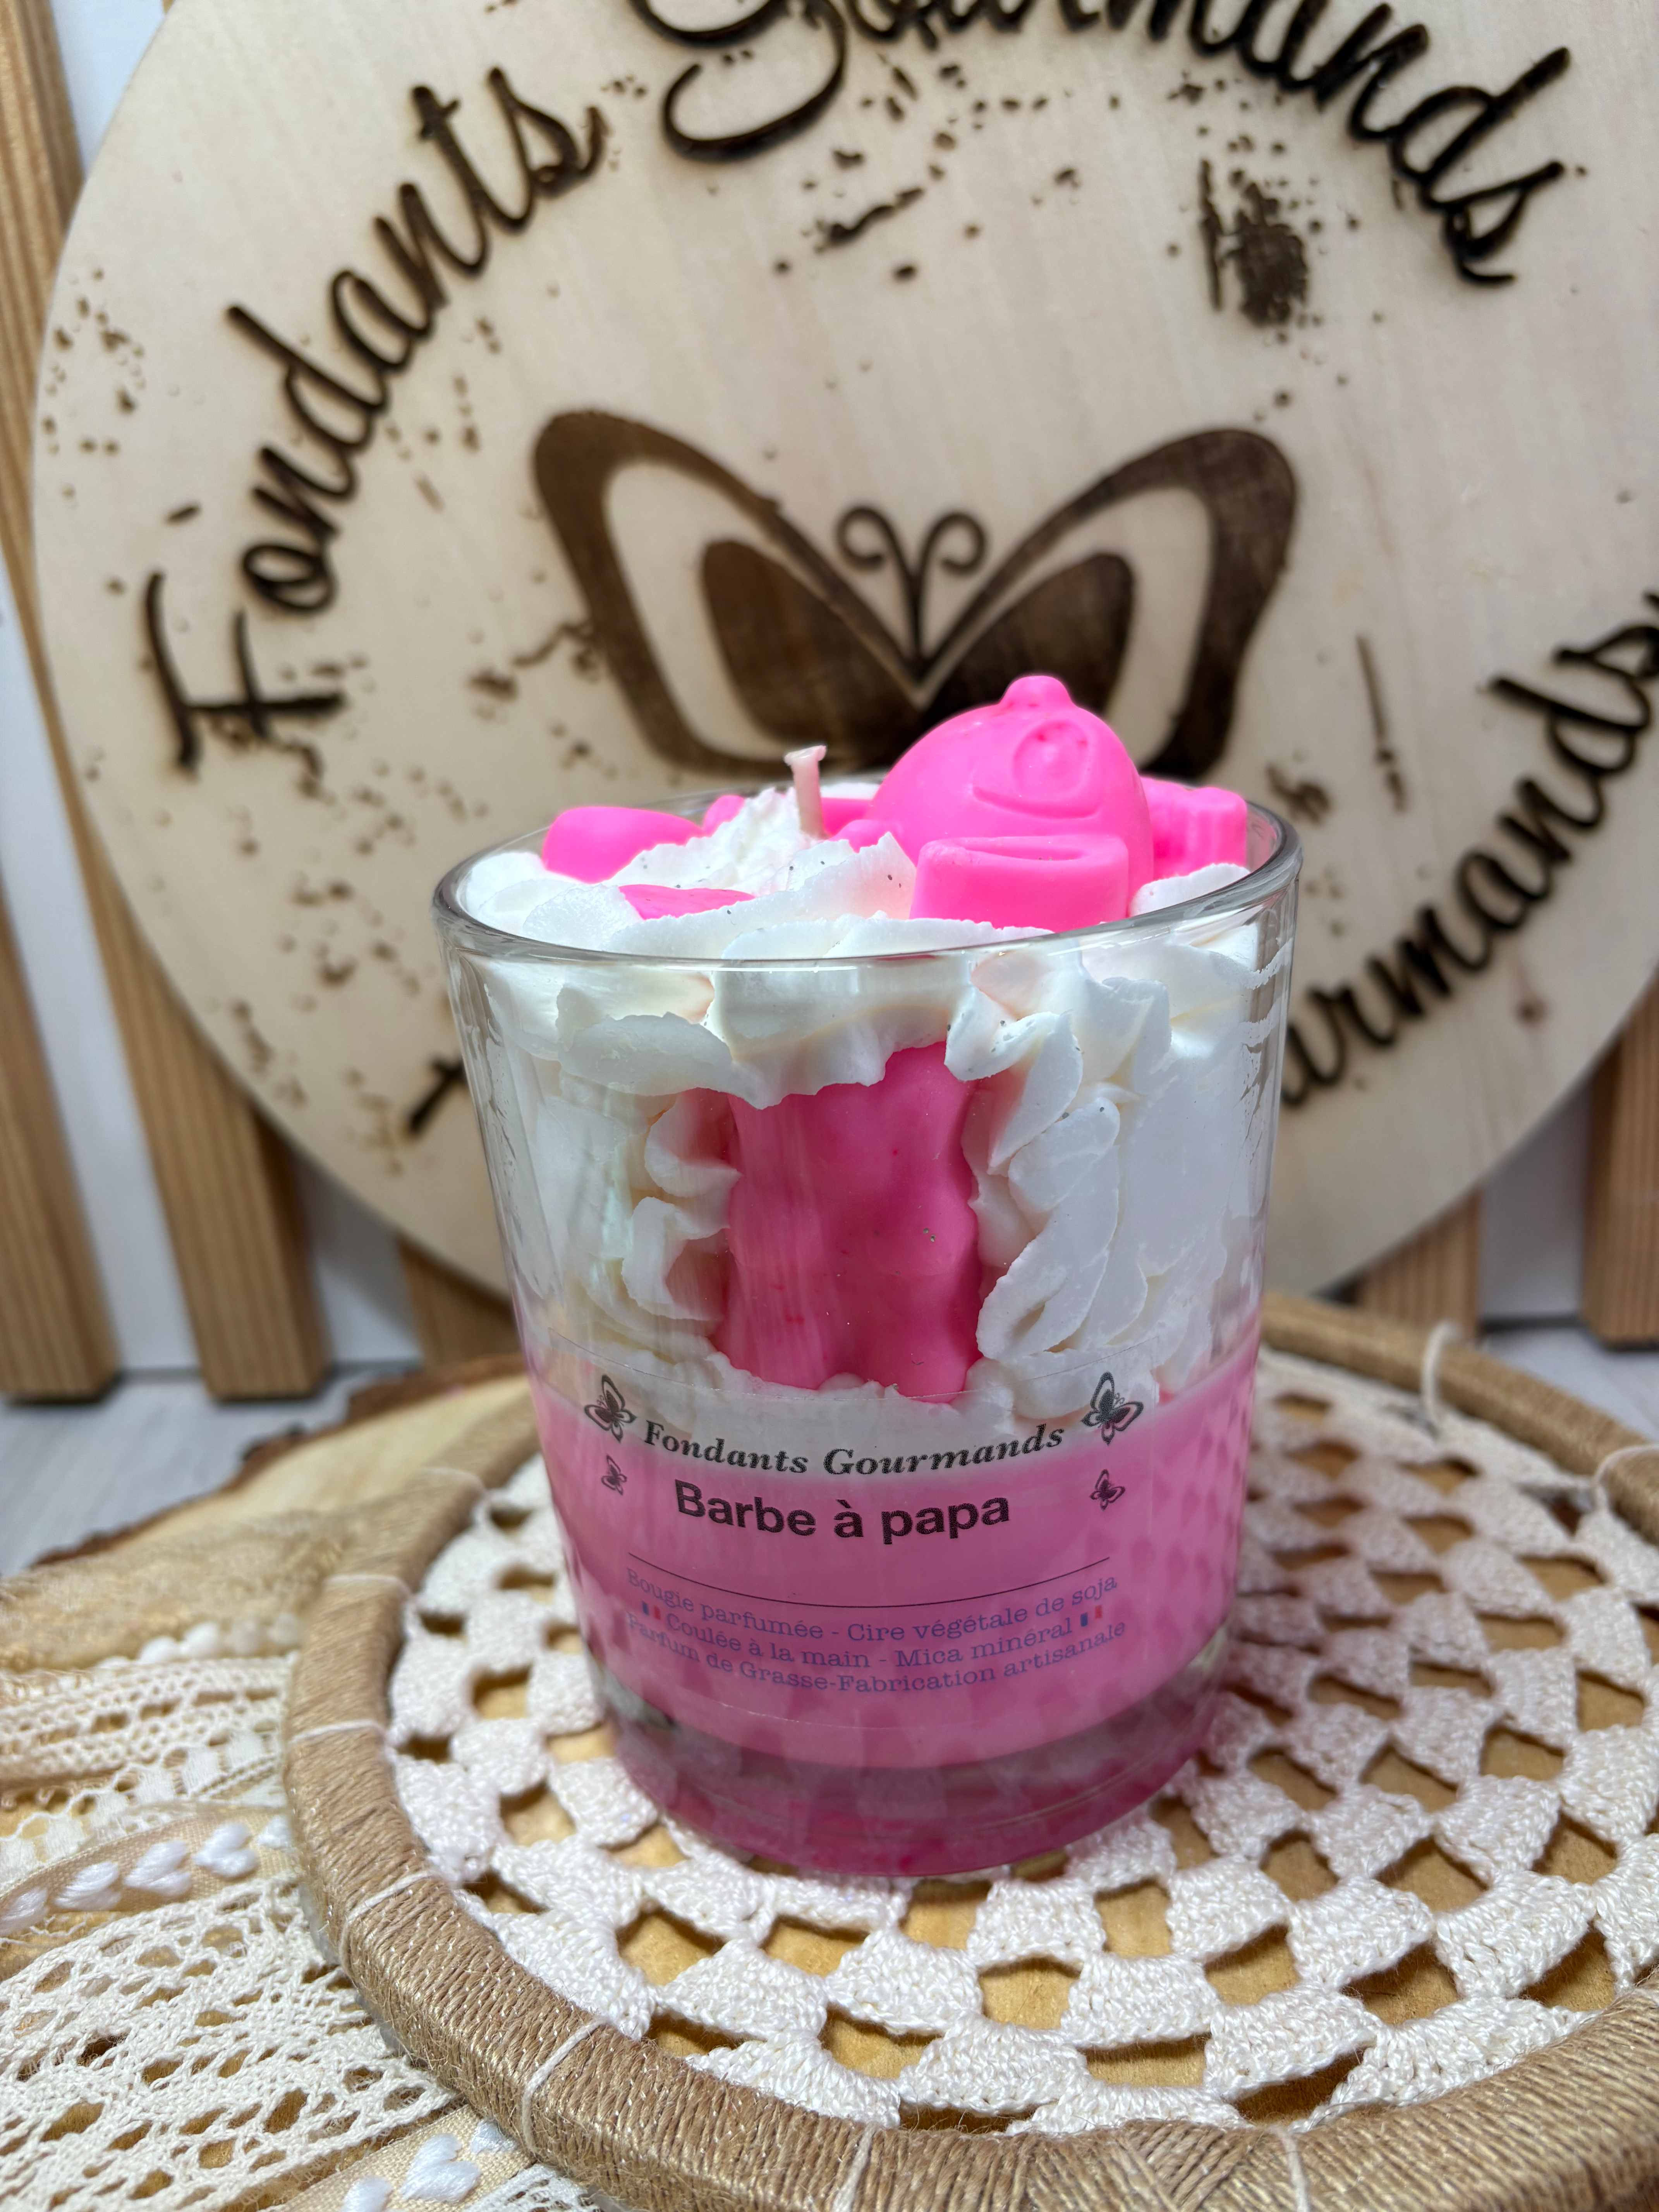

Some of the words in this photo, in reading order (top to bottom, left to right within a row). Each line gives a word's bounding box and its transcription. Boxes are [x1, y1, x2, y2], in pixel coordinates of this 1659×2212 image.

[145, 67, 607, 769] Fondants
[644, 1420, 809, 1473] Fondants
[823, 1423, 1064, 1475] Gourmands
[675, 1479, 816, 1536] Barbe
[834, 1499, 864, 1538] à
[881, 1497, 1009, 1544] papa
[627, 1567, 694, 1613] Bougie
[700, 1603, 823, 1638] parfumée
[848, 1623, 905, 1641] Cire
[913, 1608, 1027, 1639] végétale
[1036, 1598, 1064, 1617] de
[1072, 1576, 1117, 1606] soja
[627, 1611, 700, 1662] Parfum
[706, 1652, 733, 1672] de
[740, 1662, 996, 1693] Grasse-Fabrication
[1003, 1621, 1125, 1677] artisanale
[666, 1613, 741, 1651] Coulée
[749, 1638, 763, 1657] à
[771, 1642, 794, 1662] la
[801, 1650, 871, 1668] main
[895, 1648, 963, 1667] Mica
[971, 1618, 1072, 1659] minéral
